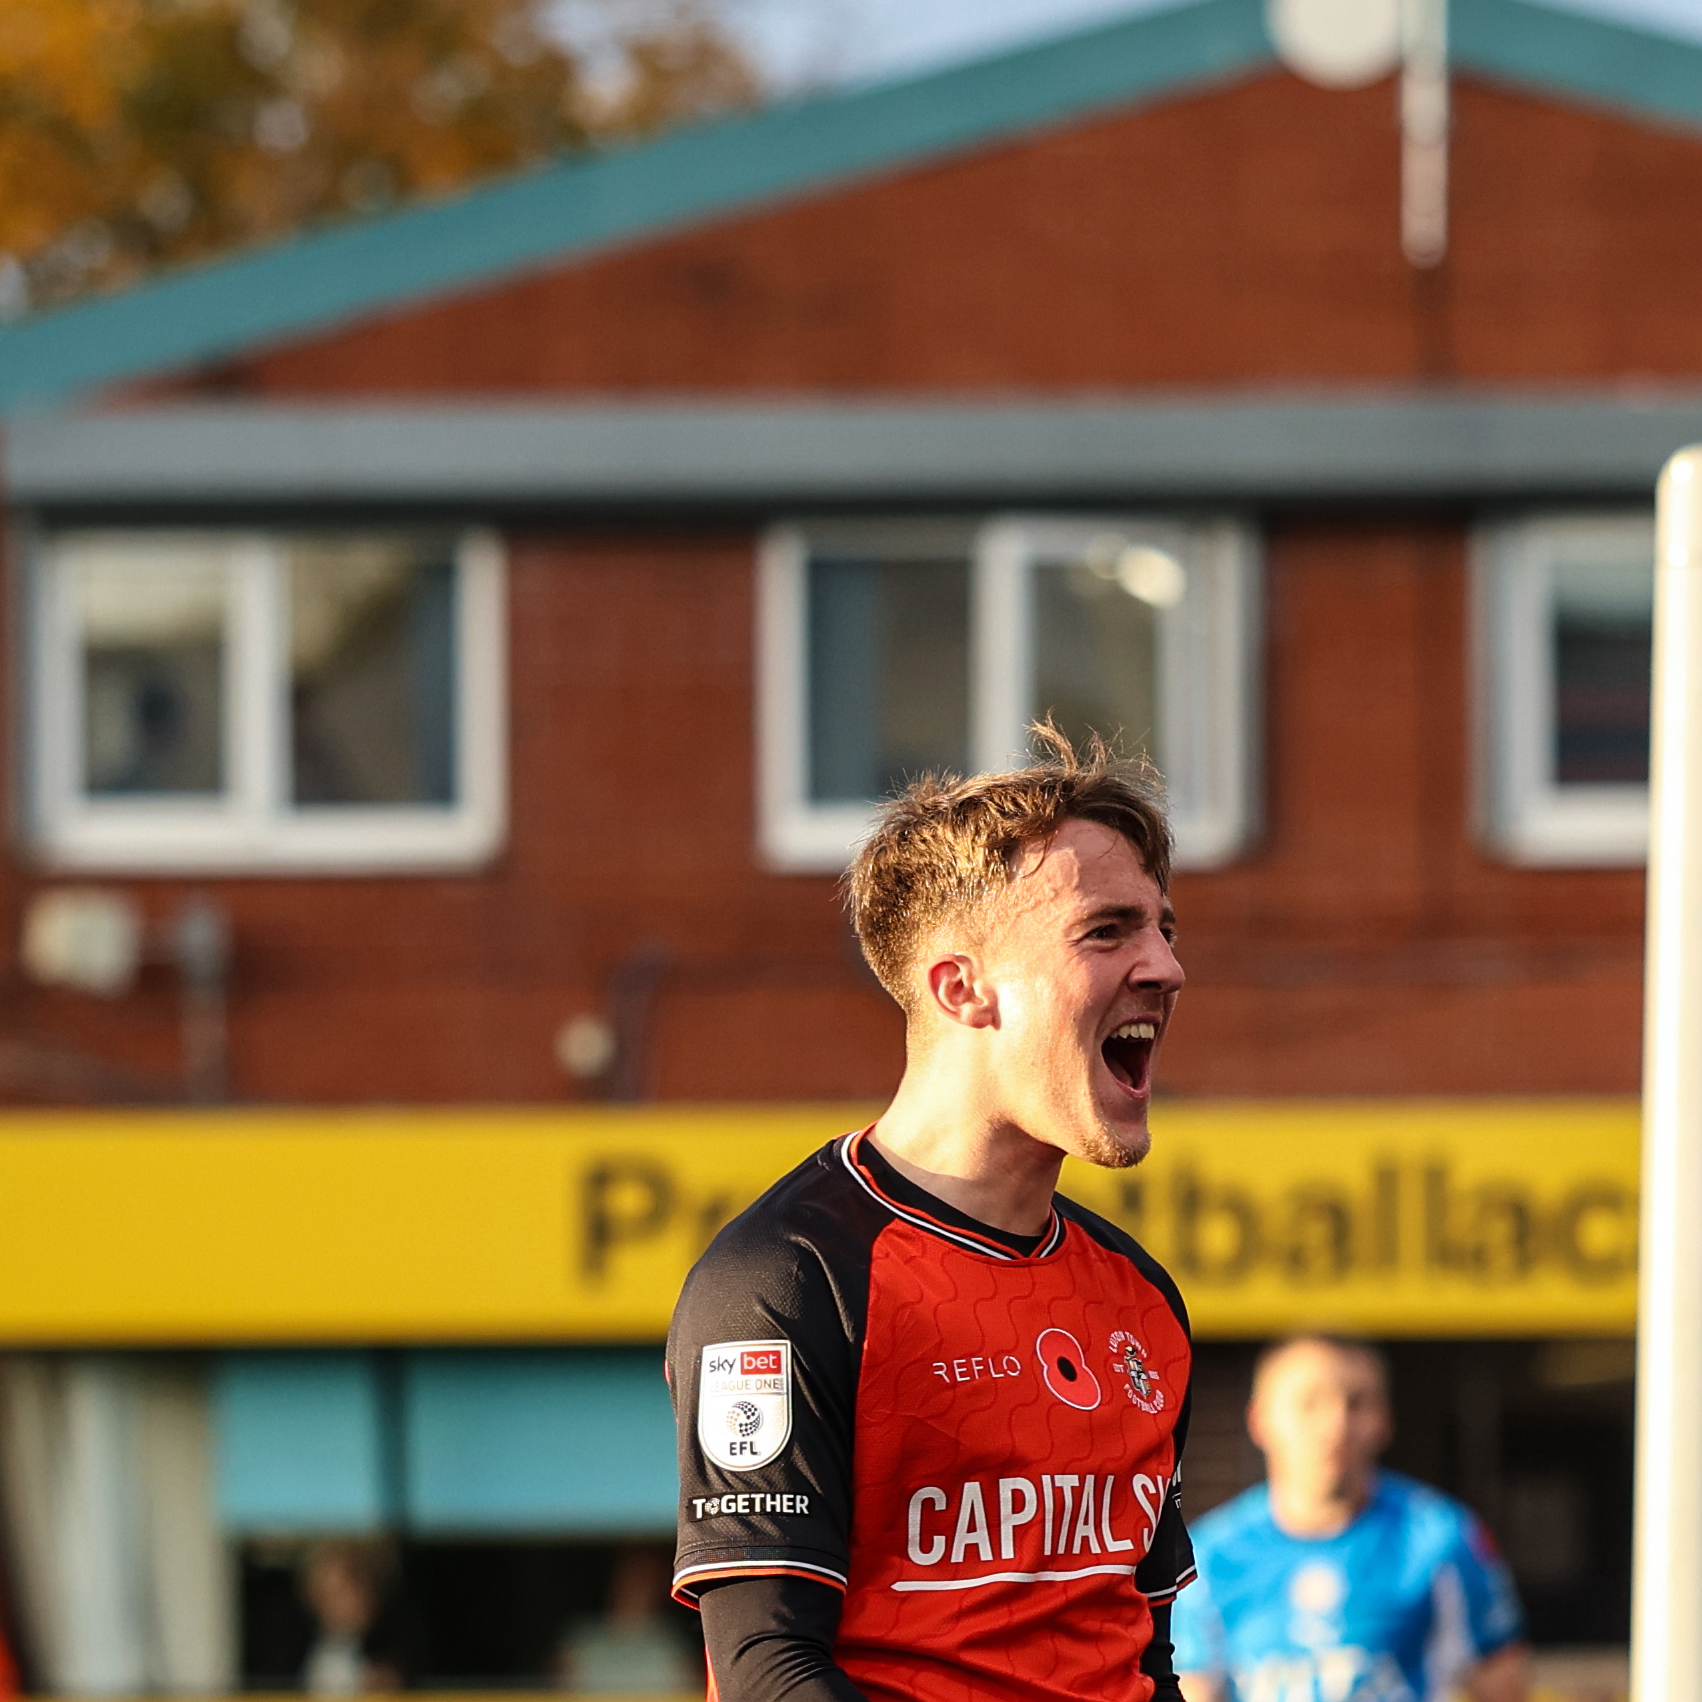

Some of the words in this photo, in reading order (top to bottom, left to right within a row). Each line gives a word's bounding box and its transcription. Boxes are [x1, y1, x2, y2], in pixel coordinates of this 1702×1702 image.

[709, 1356, 736, 1374] sky
[743, 1351, 778, 1370] bet
[933, 1355, 1021, 1383] REFLO
[755, 1378, 781, 1391] ONE
[729, 1440, 760, 1456] EFL
[692, 1493, 809, 1519] TOGETHER
[907, 1474, 1134, 1565] CAPITAL
